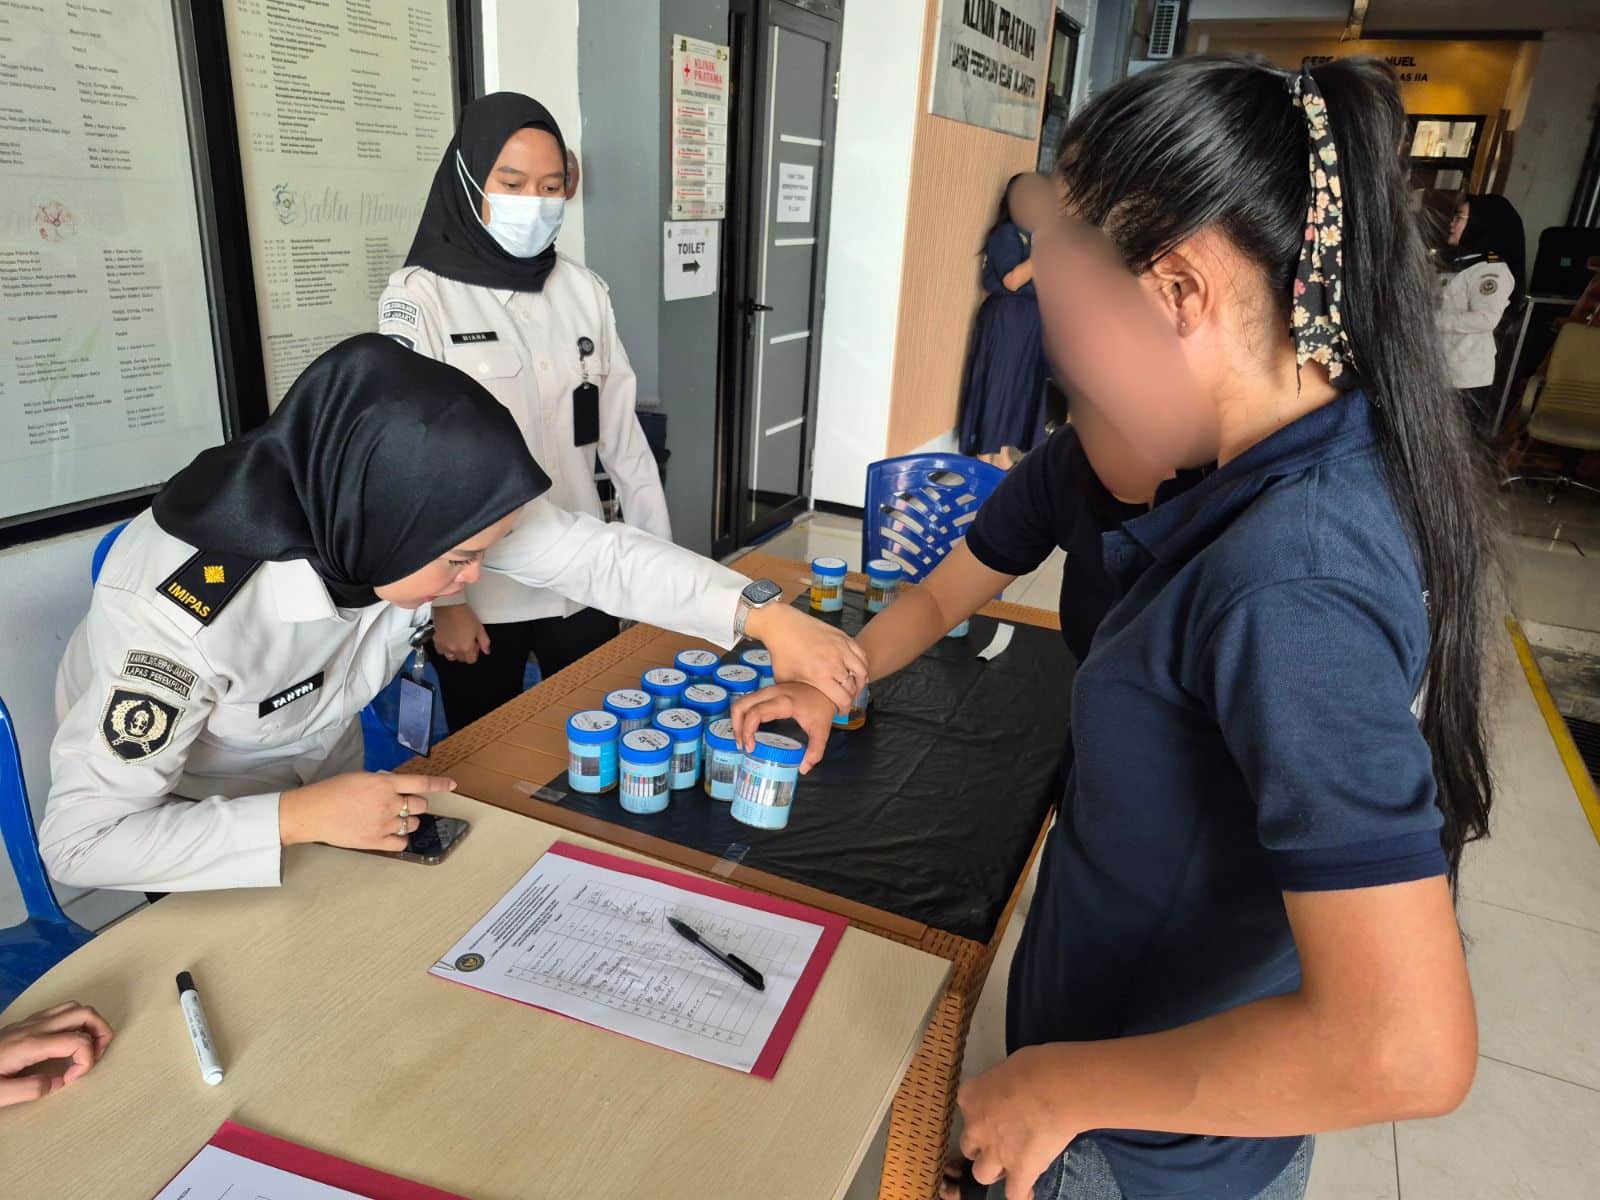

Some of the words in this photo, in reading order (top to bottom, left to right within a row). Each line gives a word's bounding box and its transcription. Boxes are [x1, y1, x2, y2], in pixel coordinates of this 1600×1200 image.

[997, 6, 1036, 61] PRATAMA
[677, 241, 706, 255] TOILET
[167, 581, 211, 617] IMIPAS
[126, 665, 149, 678] LAPAS
[149, 670, 189, 697] PEREMPUAN
